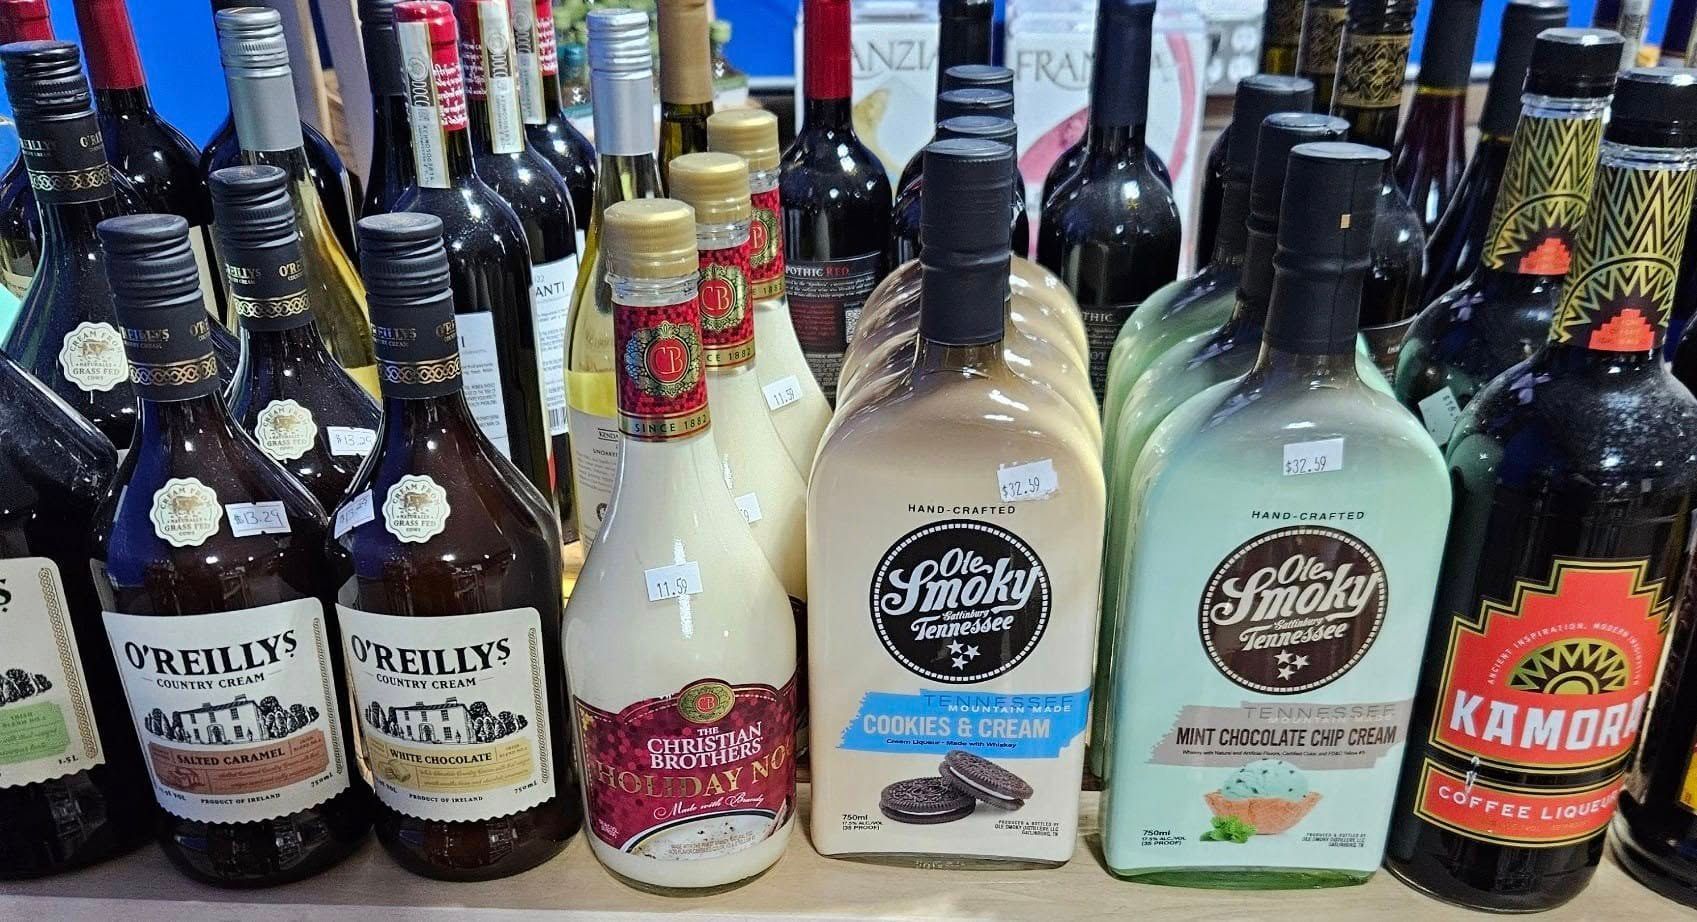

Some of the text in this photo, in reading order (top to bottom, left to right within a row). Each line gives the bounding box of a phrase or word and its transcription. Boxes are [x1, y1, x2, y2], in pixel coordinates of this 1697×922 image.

[785, 265, 824, 277] POTHIC
[702, 286, 729, 310] CB
[70, 331, 96, 351] CREAM
[654, 346, 684, 374] CB
[729, 348, 751, 360] 1882
[263, 408, 285, 427] CREAM
[635, 414, 708, 433] SINCE 1882
[1284, 456, 1327, 475] $32.59
[393, 483, 417, 504] CREAM
[1002, 476, 1041, 498] $32.59
[161, 488, 185, 509] CREAM
[908, 504, 1016, 515] HAND-CRAFTED
[1252, 510, 1366, 521] HAND-CRAFTED
[939, 547, 993, 577] Ole
[1278, 554, 1333, 585] Ole
[656, 577, 688, 598] 11.59
[880, 558, 1041, 616] Smoky
[1210, 563, 1383, 626] Smoky
[911, 615, 1015, 641] Tennessee
[1239, 622, 1348, 651] Tennessee
[1487, 648, 1513, 685] ANCIENT
[156, 672, 265, 690] COUNTRY CREAM
[376, 673, 477, 689] COUNTRY CREAM
[696, 697, 715, 710] CB
[923, 695, 1074, 708] TENNESSEE
[948, 705, 1072, 714] MOUNTAIN MADE
[1244, 704, 1396, 719] TENNESSEE
[697, 727, 719, 736] THE
[863, 713, 1051, 739] COOKIES & CREAM
[1176, 726, 1398, 747] MINT CHOCOLATE CHIP CREAM
[647, 721, 762, 755] CHRISTIAN
[177, 748, 286, 766] SALTED CARAMEL
[390, 748, 493, 765] WHITE CHOCOLATE
[650, 738, 762, 769] BROTHERS
[594, 760, 743, 798] HOLIDAY
[248, 793, 281, 803] IRELAND
[409, 793, 438, 803] PRODUCT
[653, 792, 764, 820] Made with Brandy
[1438, 786, 1532, 819] COFFEE
